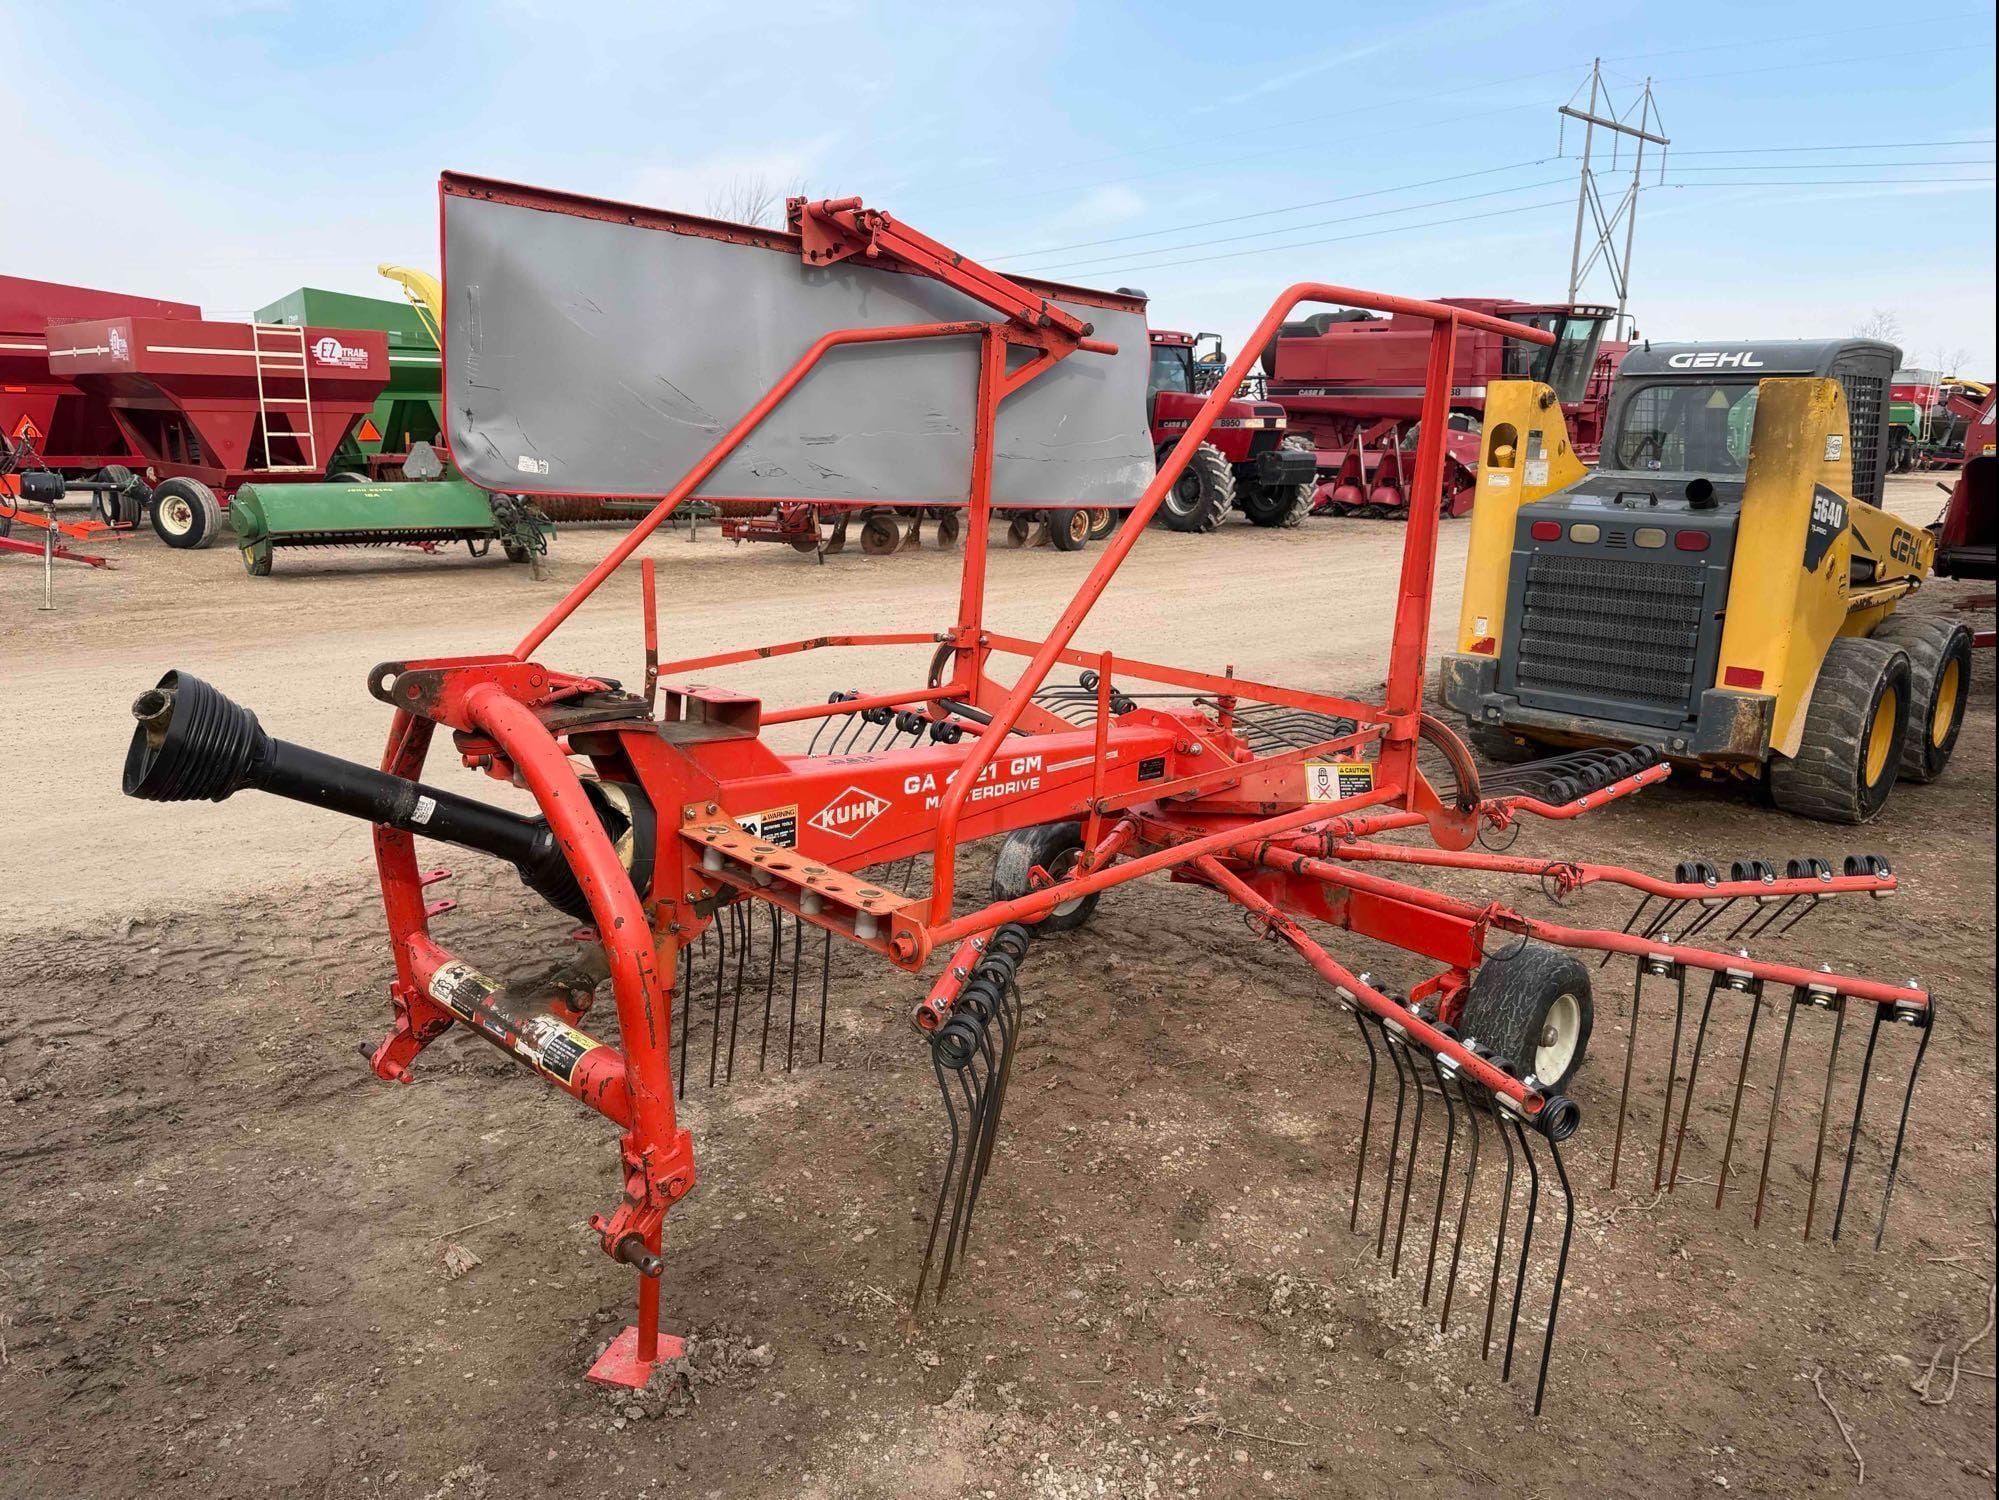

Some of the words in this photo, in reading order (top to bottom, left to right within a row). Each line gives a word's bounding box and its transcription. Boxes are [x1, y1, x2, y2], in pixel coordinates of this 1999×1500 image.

[1668, 351, 1764, 368] GEHL
[1220, 419, 1241, 428] 8950
[1813, 495, 1843, 529] 5640
[1889, 527, 1922, 570] GEHL
[903, 773, 936, 795] GA
[1010, 755, 1042, 776] GM
[767, 809, 795, 820] WARNING
[822, 799, 879, 828] KUHN
